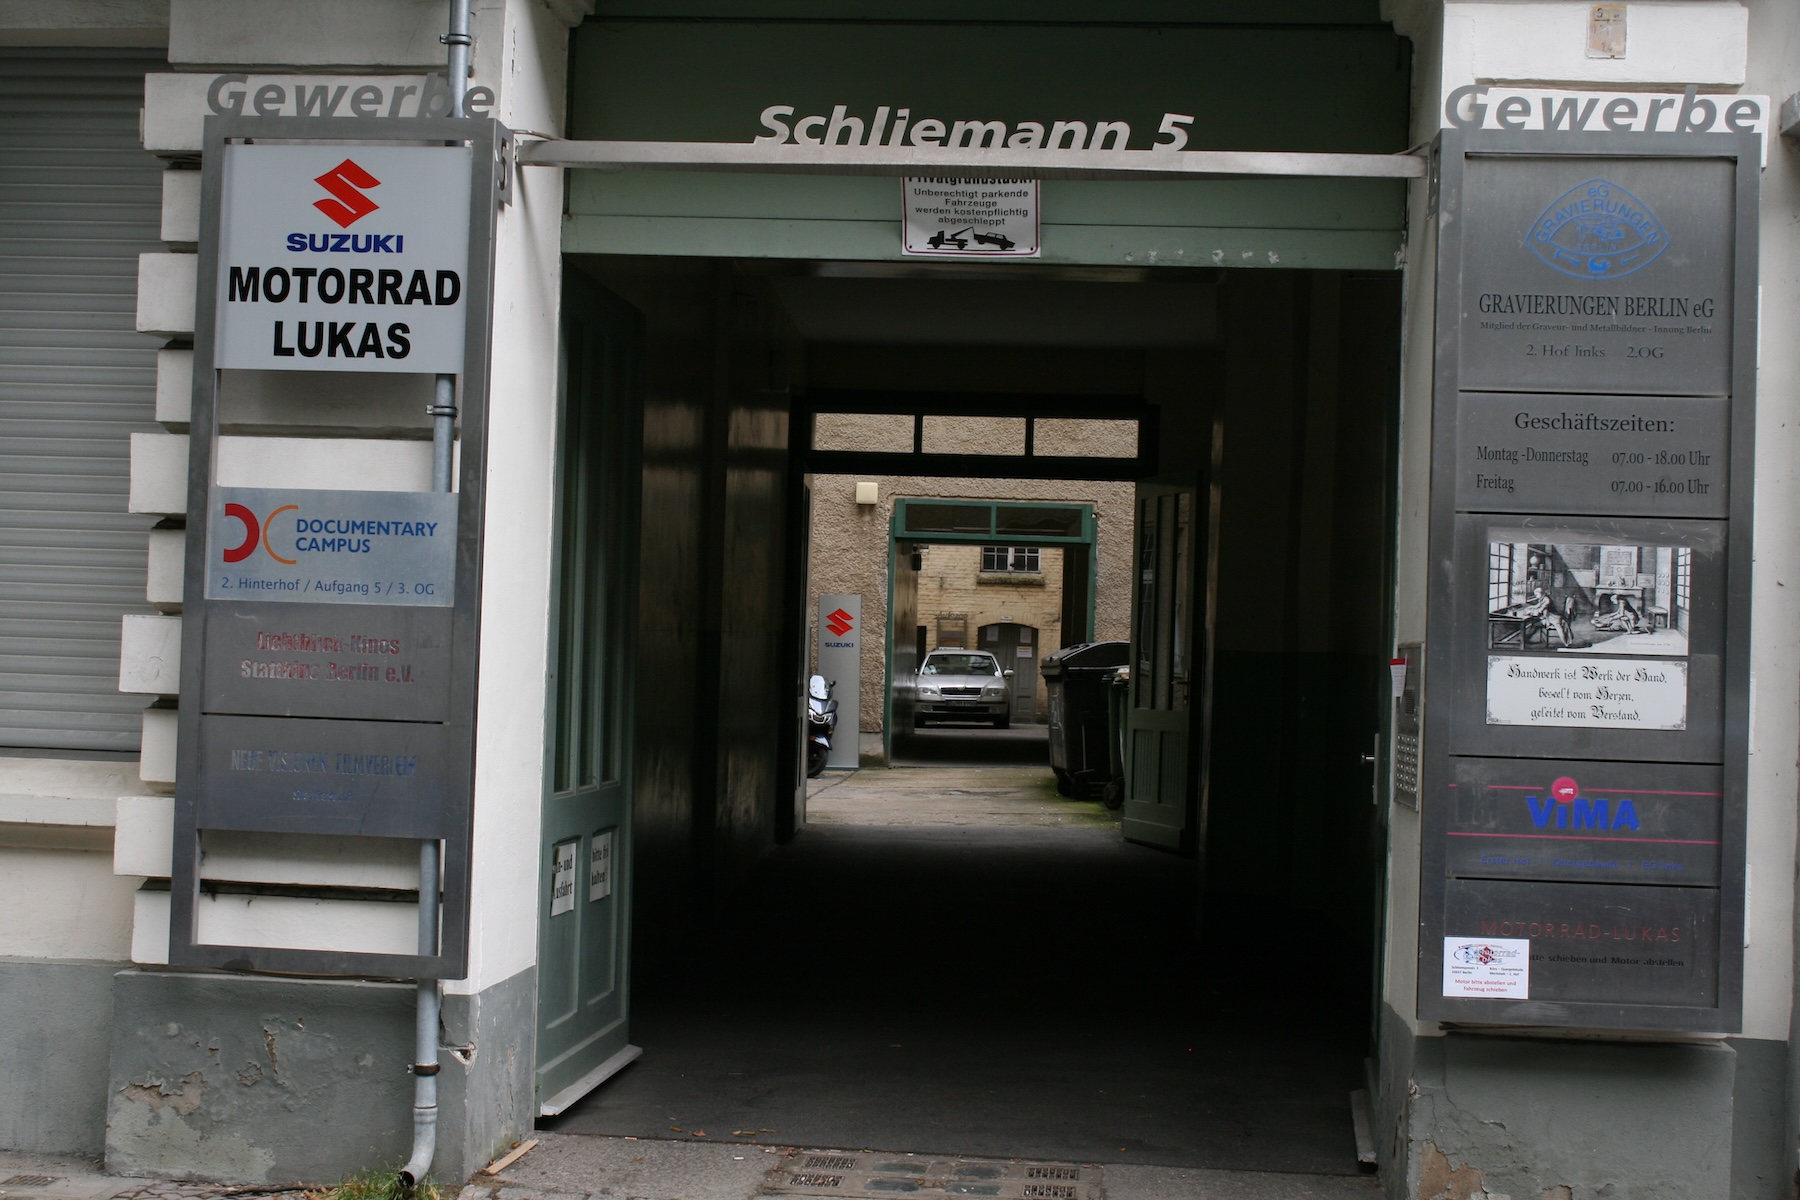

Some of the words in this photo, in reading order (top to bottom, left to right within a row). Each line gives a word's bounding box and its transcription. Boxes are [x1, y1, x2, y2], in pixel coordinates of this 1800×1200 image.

[207, 73, 496, 119] Gewerbe
[1445, 85, 1761, 134] Gewerbe
[753, 104, 1131, 150] Schliemann
[1152, 112, 1195, 151] 5
[914, 188, 978, 199] Unberechtigt
[981, 190, 1028, 199] parkende
[1587, 184, 1609, 197] eG
[915, 207, 950, 215] werden
[954, 208, 1028, 218] kostenpflichtig
[945, 198, 998, 208] Fahrzeuge
[938, 216, 1005, 226] abgeschleppt
[1535, 198, 1660, 245] GRAVIERUNGEN
[286, 233, 404, 254] SUZUKI
[228, 266, 461, 306] MOTORRAD
[1479, 293, 1619, 316] GRAVIERUNGEN
[1624, 296, 1689, 317] BERLIN
[1693, 298, 1714, 318] eG
[1480, 321, 1514, 331] Mitglied
[1516, 322, 1530, 330] der
[1532, 322, 1569, 331] Graveur-
[1590, 324, 1646, 333] Metallbildner
[1654, 326, 1684, 335] Innung
[1686, 326, 1712, 334] Berlin
[273, 321, 411, 359] LUKAS
[1526, 344, 1537, 356] 2.
[1543, 344, 1571, 356] Hof
[1576, 345, 1605, 357] links
[1627, 346, 1664, 359] 2.OG
[1514, 412, 1674, 433] Geschäftszeiten:
[1477, 446, 1518, 464] Montag
[1612, 452, 1644, 467] 07.00
[1655, 450, 1686, 466] 18.00
[1689, 451, 1711, 466] Uhr
[1476, 474, 1515, 493] Freitag
[1611, 481, 1644, 496] 07.00
[1654, 478, 1685, 494] 16.00
[1688, 479, 1710, 494] Uhr
[296, 518, 438, 537] DOCUMENTARY
[295, 537, 371, 553] CAMPUS
[221, 577, 233, 589] 2.
[238, 578, 300, 591] Hinterhof
[304, 580, 311, 592] /
[314, 580, 369, 596] Aufgang
[374, 582, 381, 594] 5
[386, 582, 392, 595] /
[398, 583, 409, 595] 3.
[414, 583, 435, 596] OG
[385, 664, 415, 683] e.V.
[1507, 664, 1560, 679] Handwerk
[1564, 668, 1577, 680] ist
[1580, 666, 1613, 681] Werk
[1616, 670, 1631, 682] der
[1573, 692, 1592, 700] vom
[1530, 706, 1564, 721] geleitet
[1567, 711, 1586, 719] vom
[1548, 954, 1587, 964] schieben
[1611, 957, 1640, 966] Motor
[1643, 958, 1684, 967] abstellen
